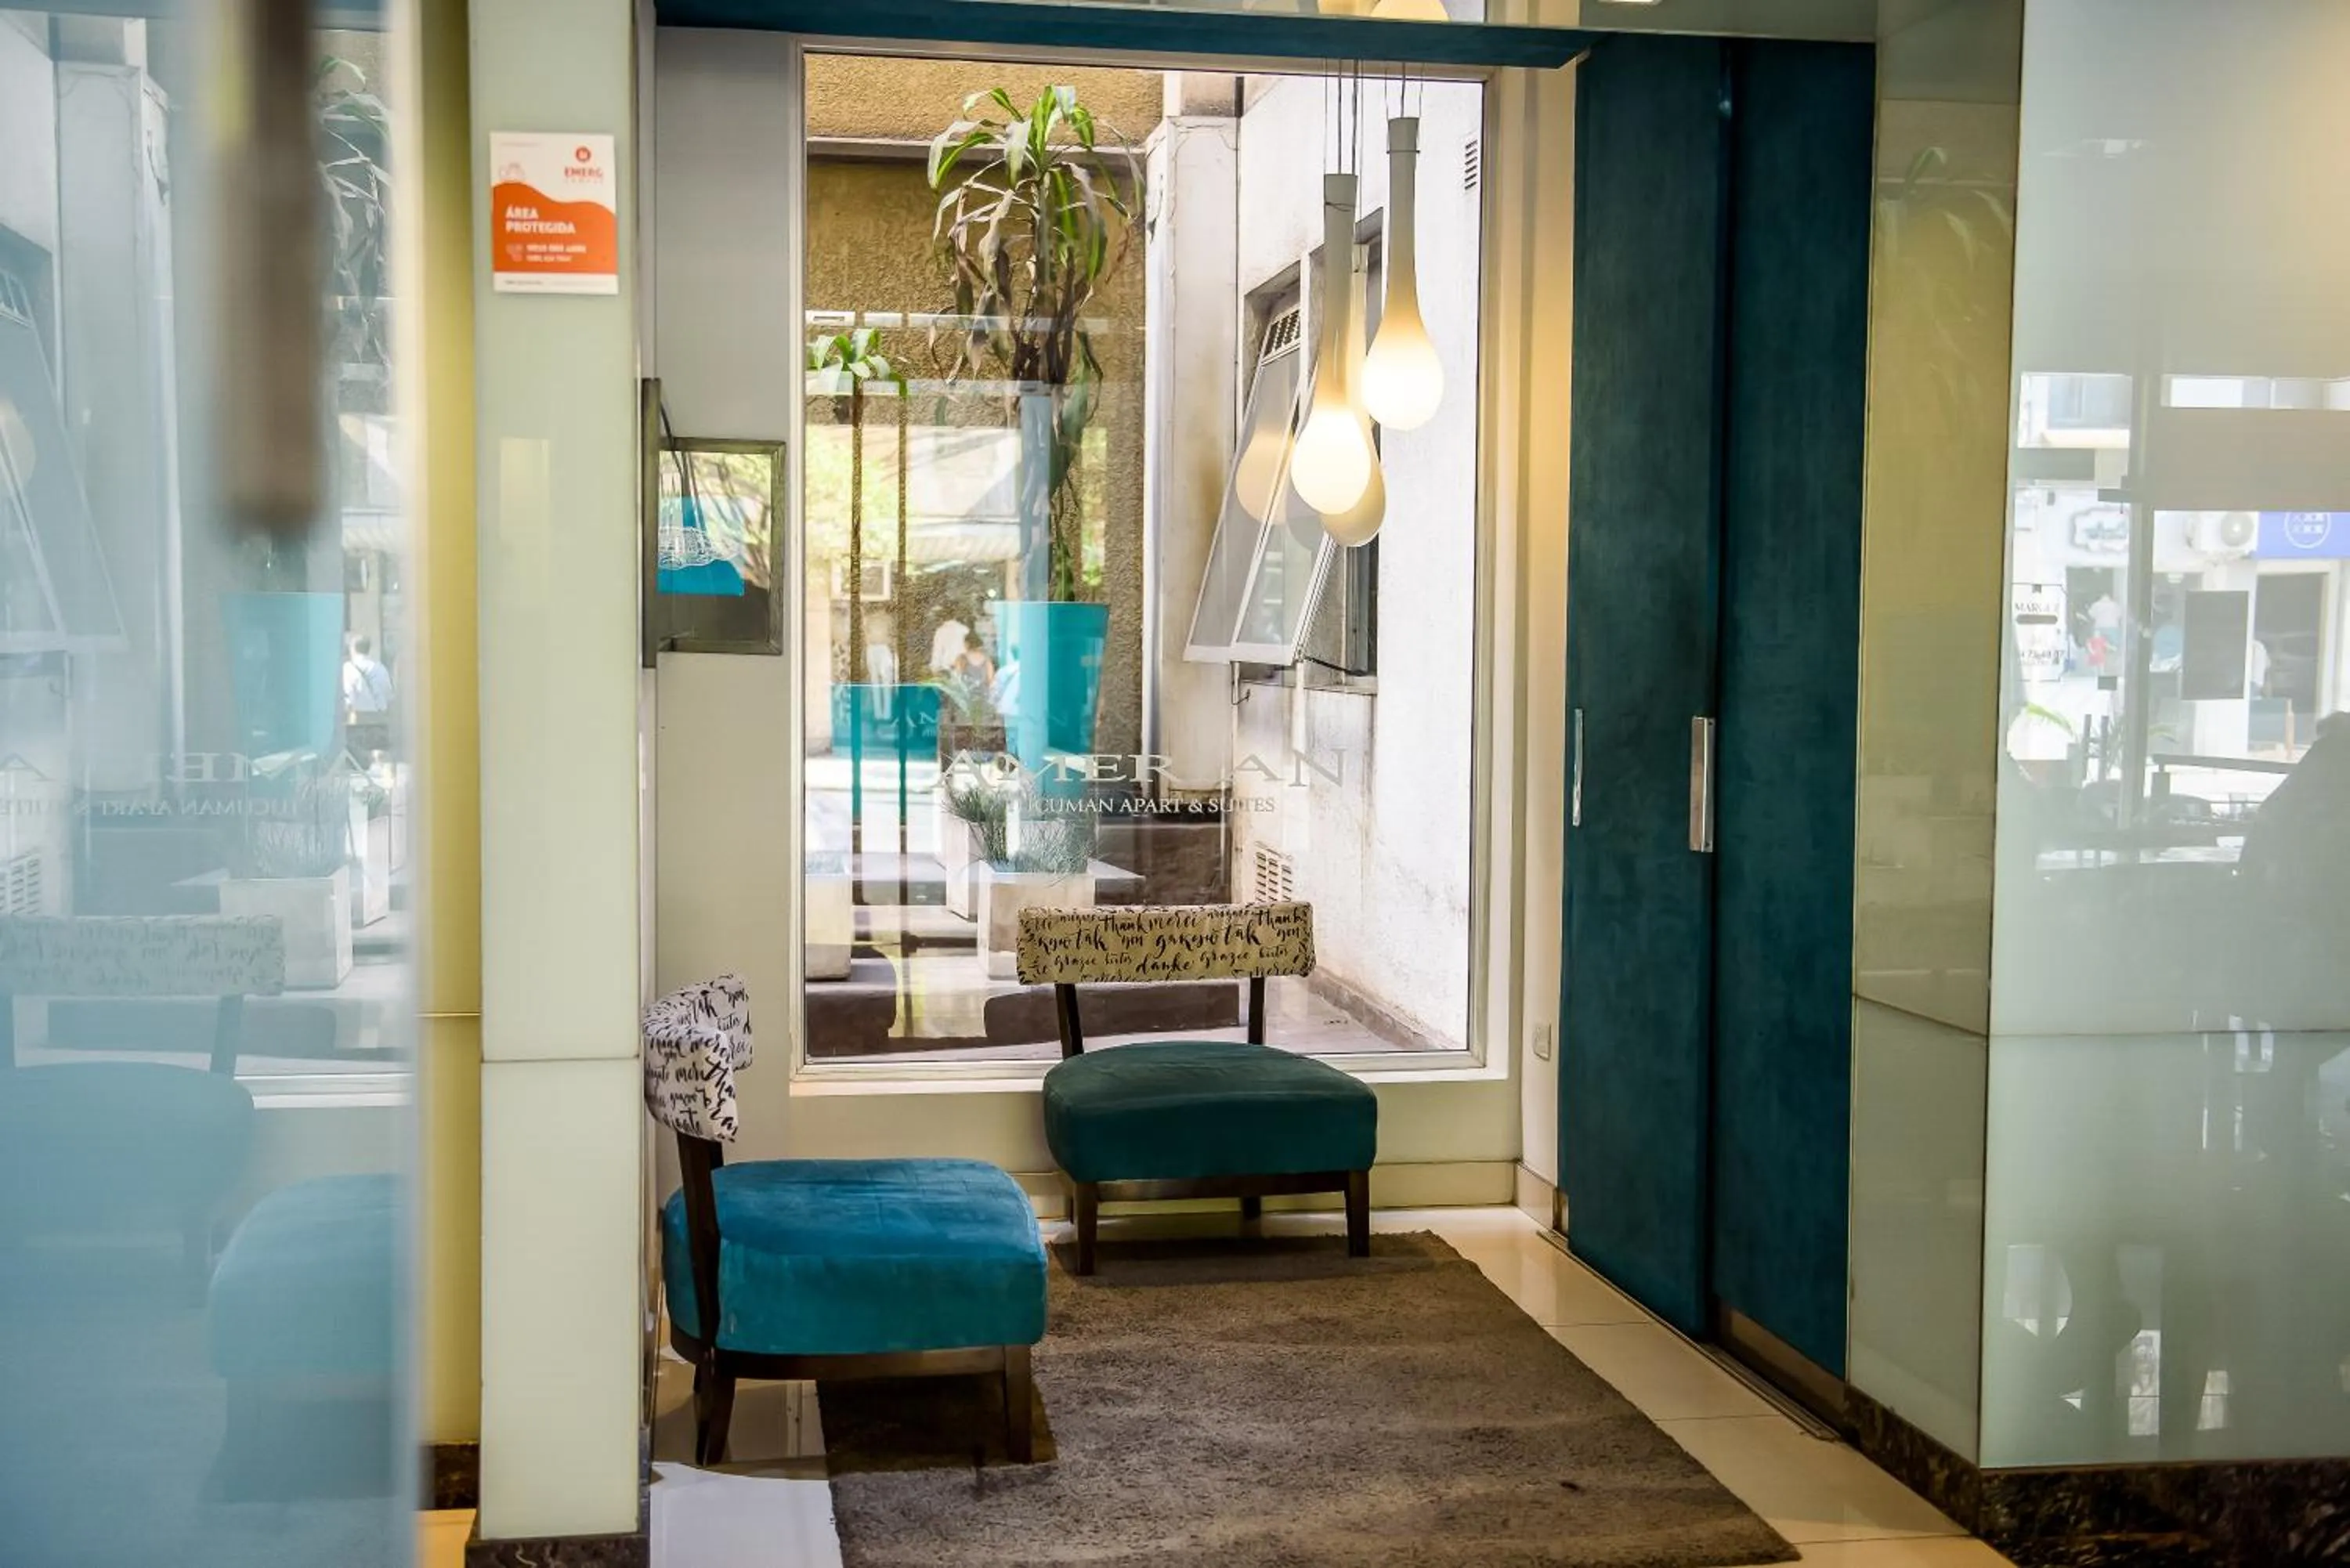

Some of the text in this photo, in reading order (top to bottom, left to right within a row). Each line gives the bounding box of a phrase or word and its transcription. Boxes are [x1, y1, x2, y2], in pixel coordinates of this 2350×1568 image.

[505, 221, 576, 234] PROTEGIDA
[931, 748, 1347, 788] AMERAN
[1119, 797, 1184, 814] APART
[1188, 798, 1204, 813] &
